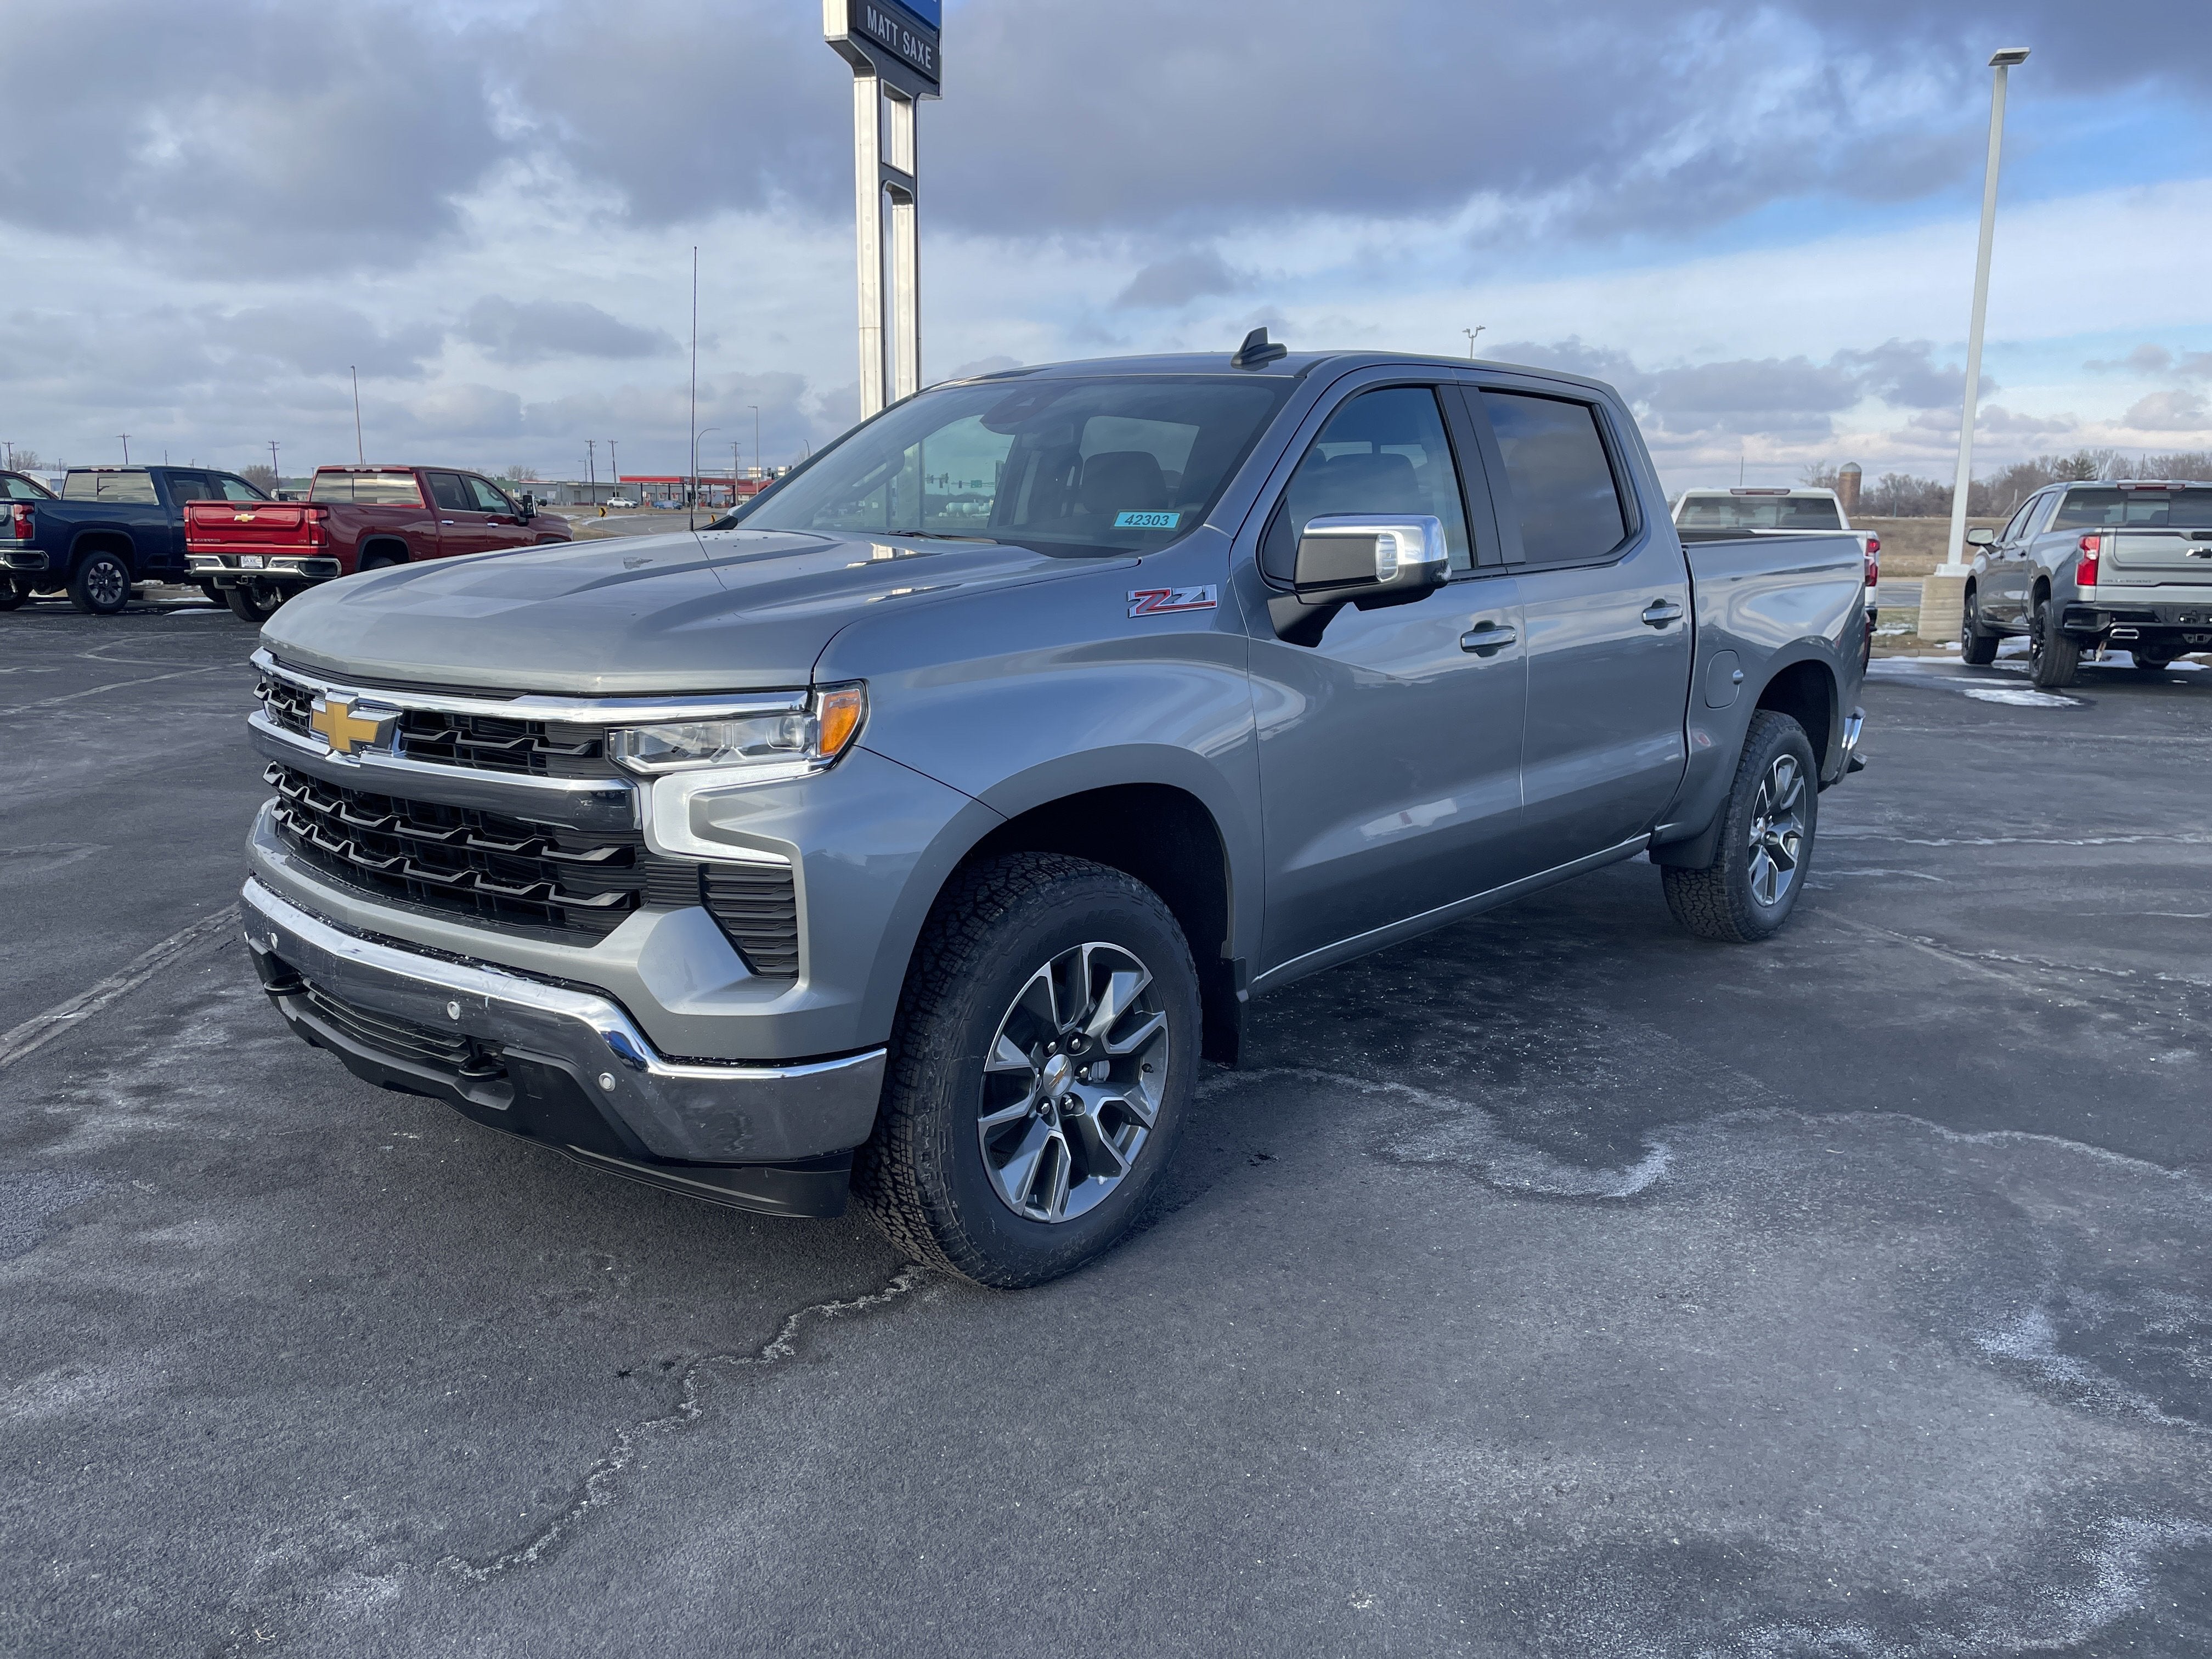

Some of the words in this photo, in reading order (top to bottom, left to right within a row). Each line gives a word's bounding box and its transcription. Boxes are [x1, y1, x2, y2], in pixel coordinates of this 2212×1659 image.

[866, 5, 899, 47] MATT
[902, 31, 932, 70] SAXE
[1124, 514, 1170, 526] 42303
